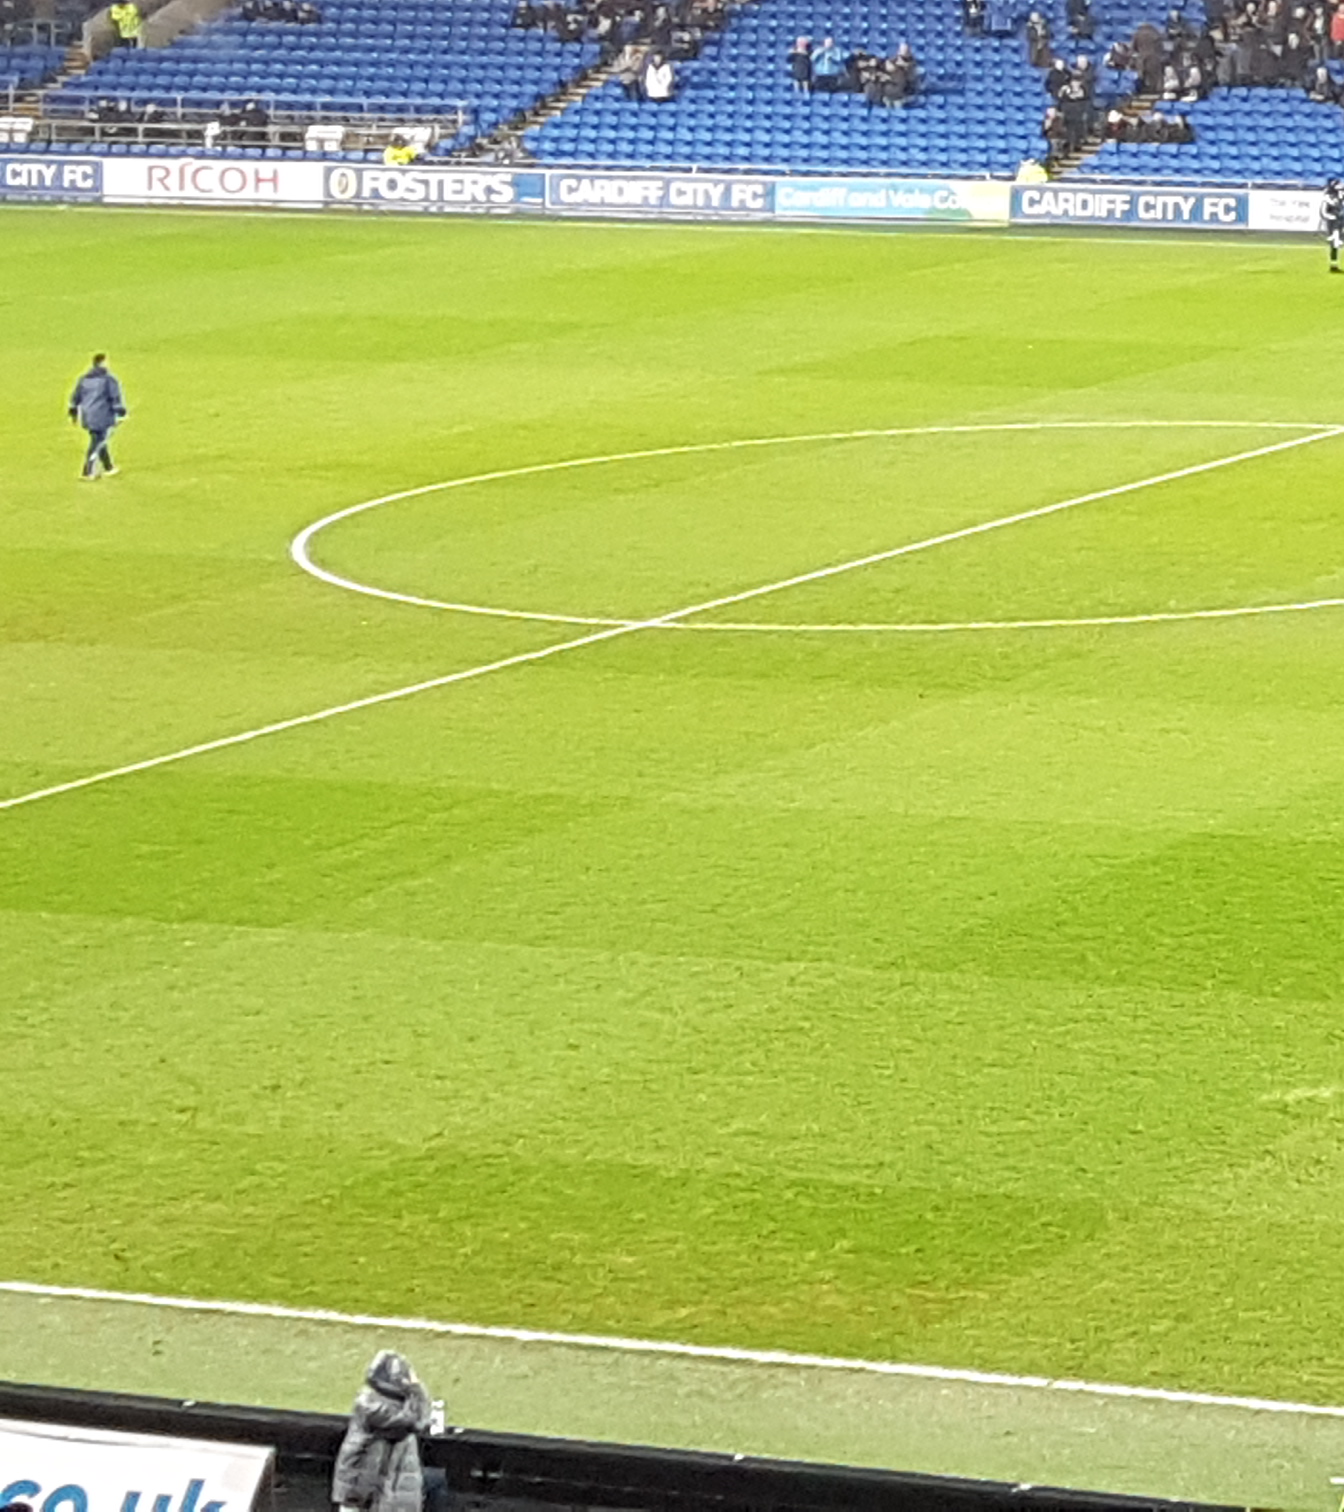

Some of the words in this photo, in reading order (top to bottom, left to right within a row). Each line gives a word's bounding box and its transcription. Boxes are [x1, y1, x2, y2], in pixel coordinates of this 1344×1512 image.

[5, 162, 56, 186] CITY
[62, 165, 94, 188] FC
[147, 161, 279, 194] RICOH
[361, 170, 513, 204] FOSTER'S
[559, 178, 664, 205] CARDIFF
[668, 183, 725, 207] CITY
[731, 185, 765, 209] FC
[1021, 190, 1132, 218] CARDIFF
[1137, 194, 1195, 220] CITY
[1202, 196, 1237, 221] FC
